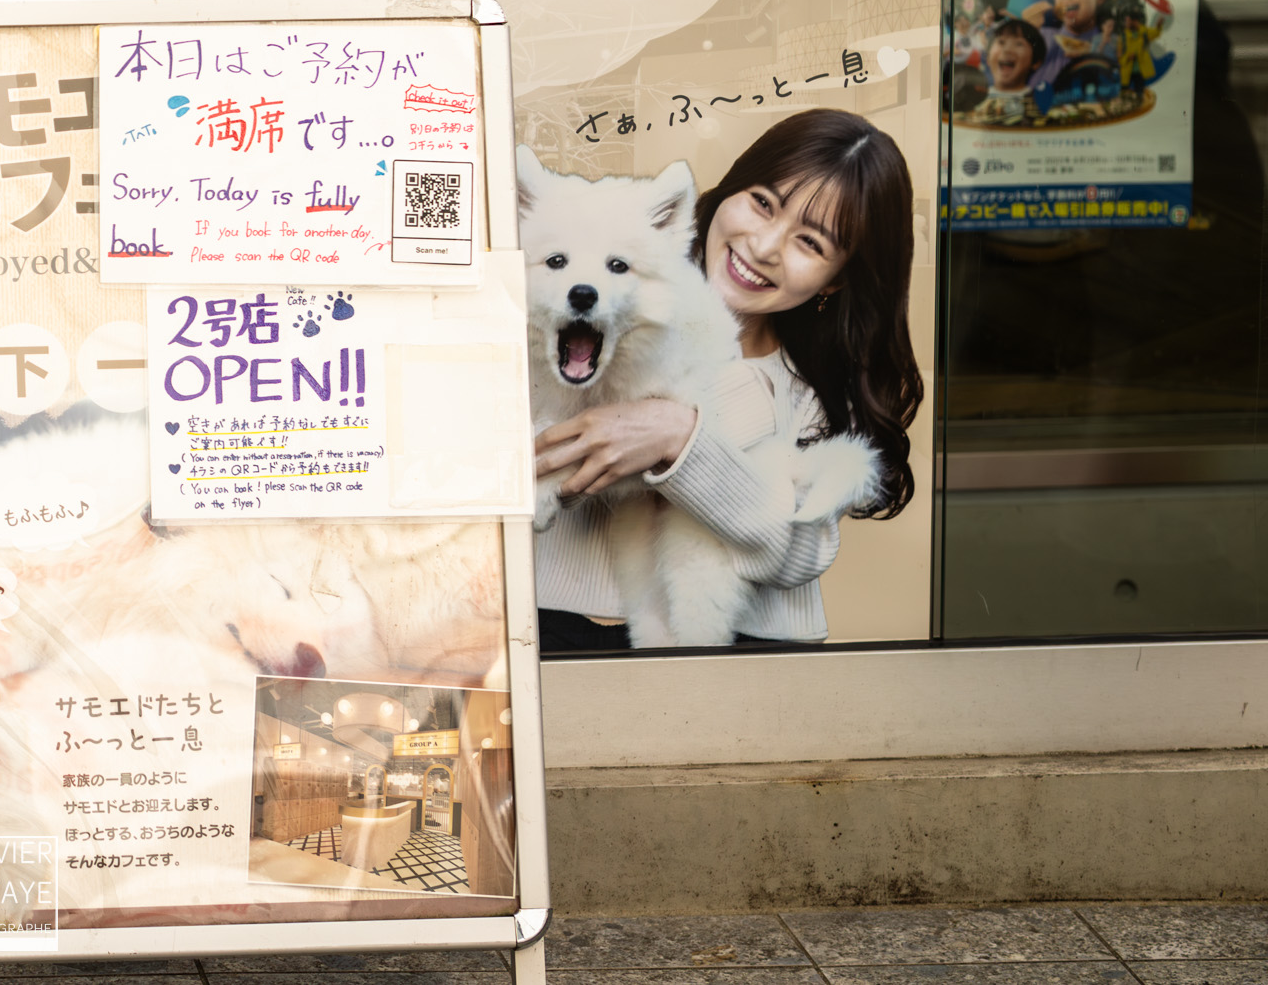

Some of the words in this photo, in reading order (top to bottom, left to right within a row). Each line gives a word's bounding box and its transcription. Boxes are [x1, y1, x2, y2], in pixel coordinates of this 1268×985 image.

[114, 29, 425, 88] 本日はご予約が
[190, 177, 259, 211] Today
[273, 189, 293, 206] is
[305, 179, 361, 215] fully
[195, 220, 210, 236] If
[218, 226, 239, 241] you
[246, 221, 272, 238] book
[279, 221, 299, 238] for
[304, 226, 349, 239] another
[190, 246, 225, 263] Please
[234, 252, 262, 262] scan
[267, 249, 285, 263] the
[289, 247, 310, 263] QR
[315, 249, 340, 263] code
[435, 247, 449, 255] me!
[286, 285, 305, 294] New
[166, 293, 280, 348] 2号店
[164, 347, 366, 408] OPEN!!
[222, 454, 241, 462] enter
[243, 452, 269, 461] without
[326, 449, 344, 459] there
[346, 450, 353, 458] is
[214, 486, 229, 494] can
[289, 484, 308, 492] scan
[310, 482, 324, 492] the
[326, 482, 342, 492] QR
[345, 483, 363, 491] code
[195, 501, 206, 509] on
[212, 499, 225, 509] the
[55, 692, 224, 719] サモエドたちと
[62, 771, 188, 788] 家族の一員のように
[63, 797, 221, 815] サモエドとお迎えします。
[65, 824, 235, 842] ほっとする、おうちのような
[65, 853, 181, 869] そんなカフェです。
